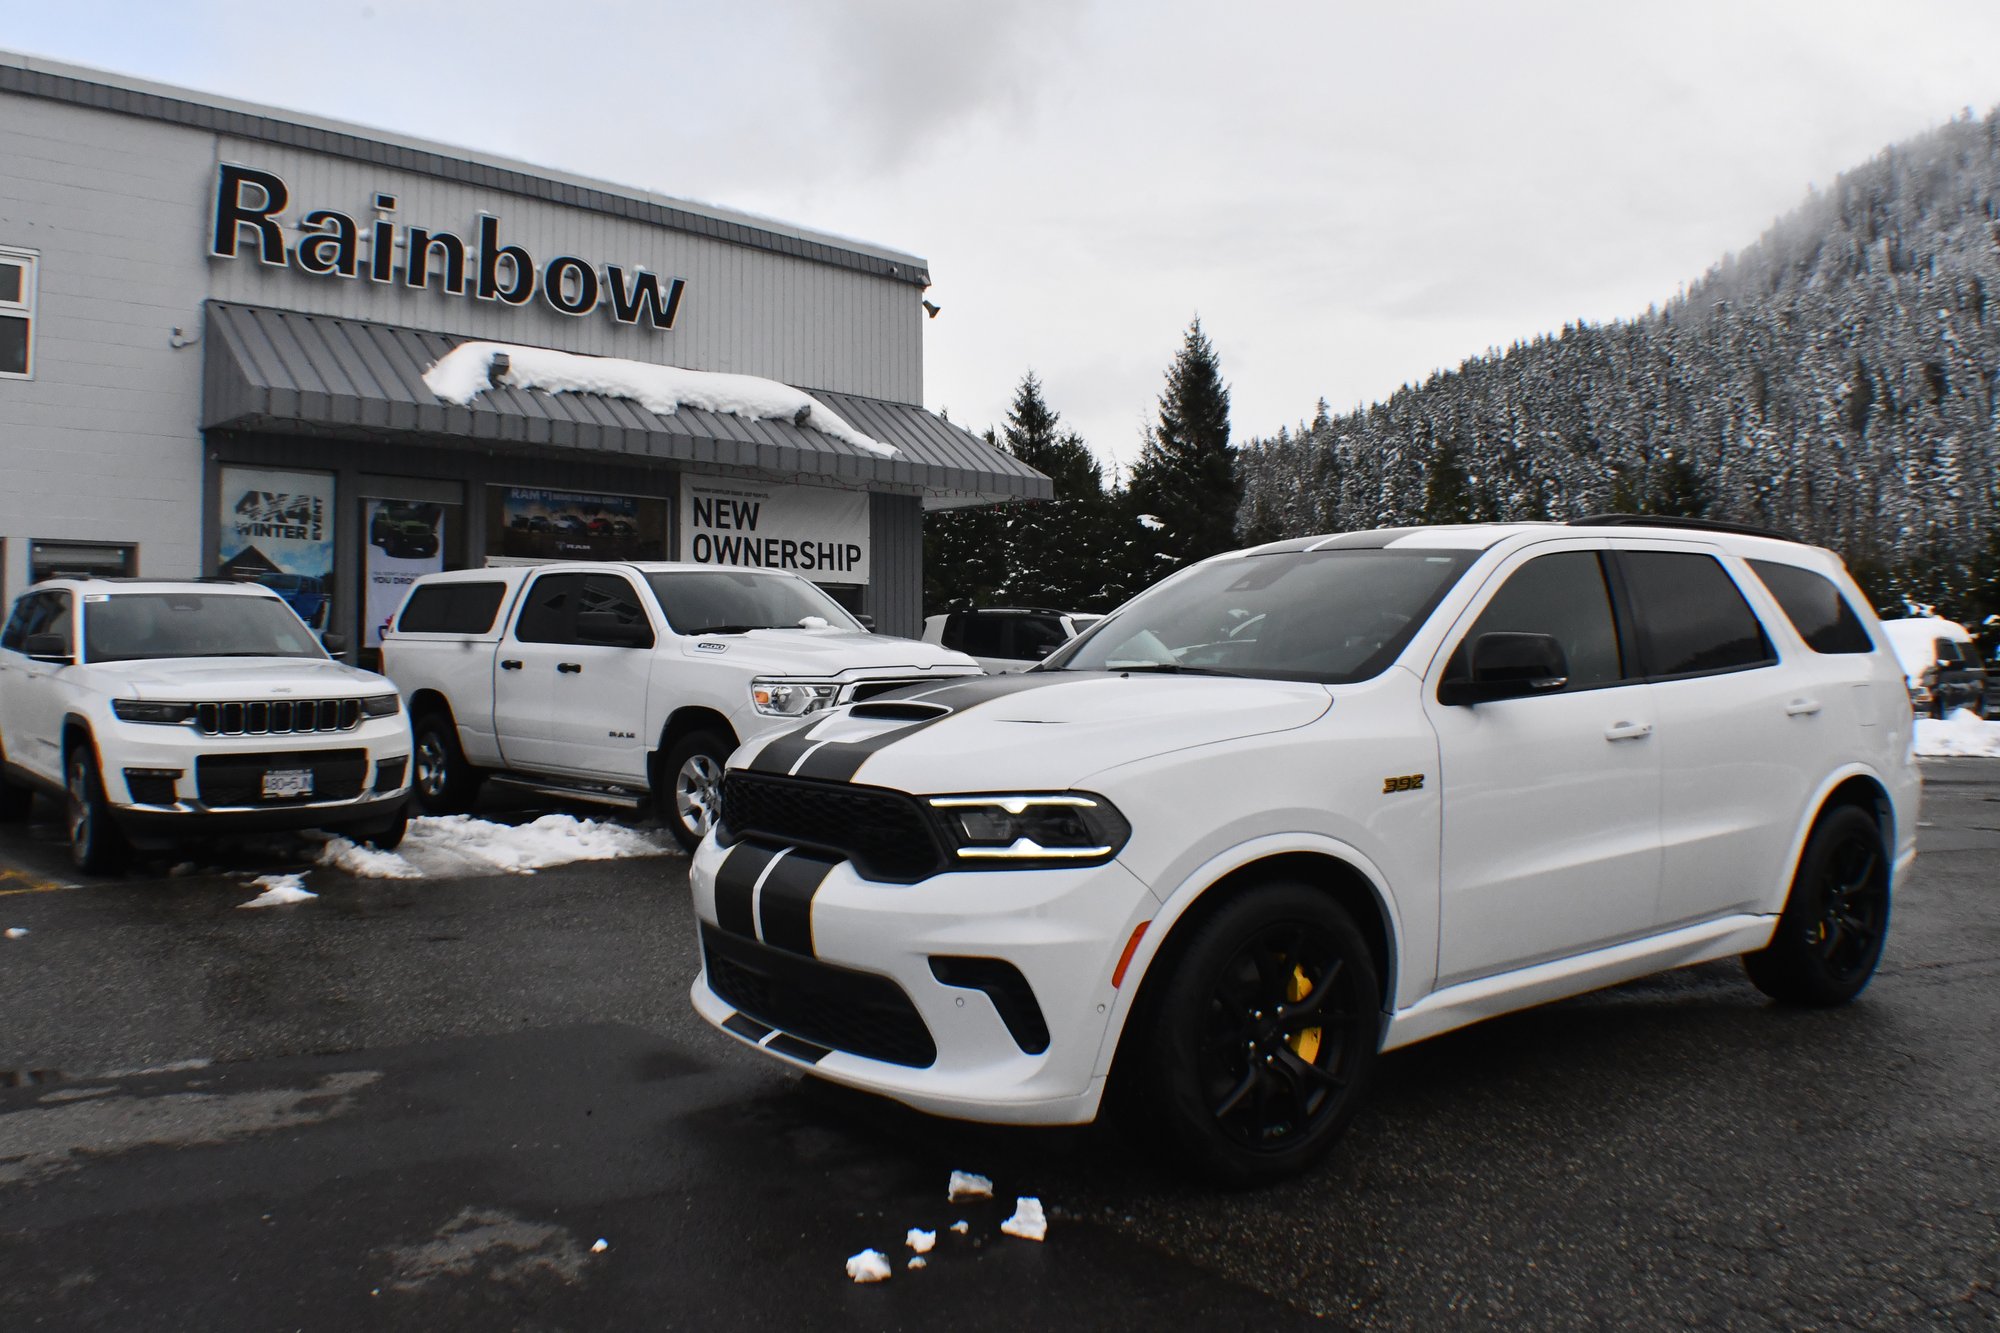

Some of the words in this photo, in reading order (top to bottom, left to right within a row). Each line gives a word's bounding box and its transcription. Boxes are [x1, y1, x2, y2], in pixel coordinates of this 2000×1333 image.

[211, 161, 688, 330] Rainbow
[511, 488, 540, 500] RAM
[693, 496, 760, 531] NEW
[236, 521, 308, 540] WINTER
[693, 533, 862, 572] OWNERSHIP
[373, 576, 391, 584] YOU
[1382, 773, 1425, 794] 392
